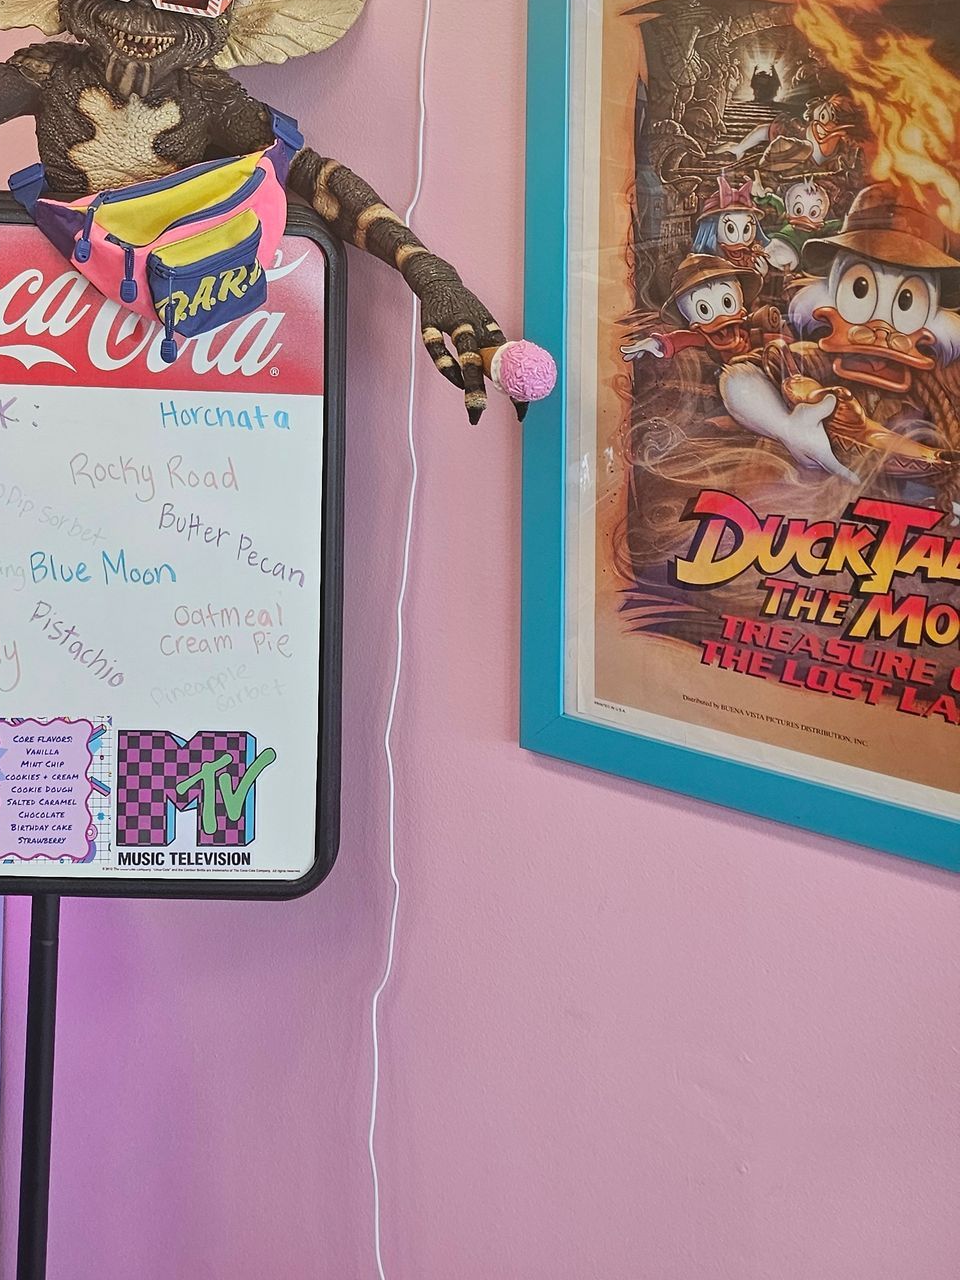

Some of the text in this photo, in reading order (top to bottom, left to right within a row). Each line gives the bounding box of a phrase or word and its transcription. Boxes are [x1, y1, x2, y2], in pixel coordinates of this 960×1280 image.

[160, 400, 291, 430] Horchata
[69, 452, 239, 502] Rocky Road
[40, 505, 107, 546] Sorbet
[159, 502, 306, 588] Butter Pecan
[30, 548, 177, 585] Blue Moon
[174, 603, 283, 629] Oatmeal
[761, 577, 852, 625] THE
[849, 594, 960, 648] MO
[30, 600, 124, 688] Pistachio
[253, 631, 293, 658] Pie
[720, 613, 936, 686] TREASURE
[699, 639, 774, 676] THE
[778, 658, 895, 705] LOST
[896, 682, 960, 726] LA
[682, 694, 713, 709] Distributed
[713, 702, 720, 711] by
[720, 703, 745, 717] BUENA
[745, 709, 766, 721] VISTA
[765, 715, 800, 730] PICTURES
[13, 735, 35, 743] CORE
[45, 760, 65, 768] CHIP
[116, 730, 277, 846] MTV
[18, 836, 66, 844] STRAWBERRY
[118, 852, 251, 866] MUSIC TELEVISION
